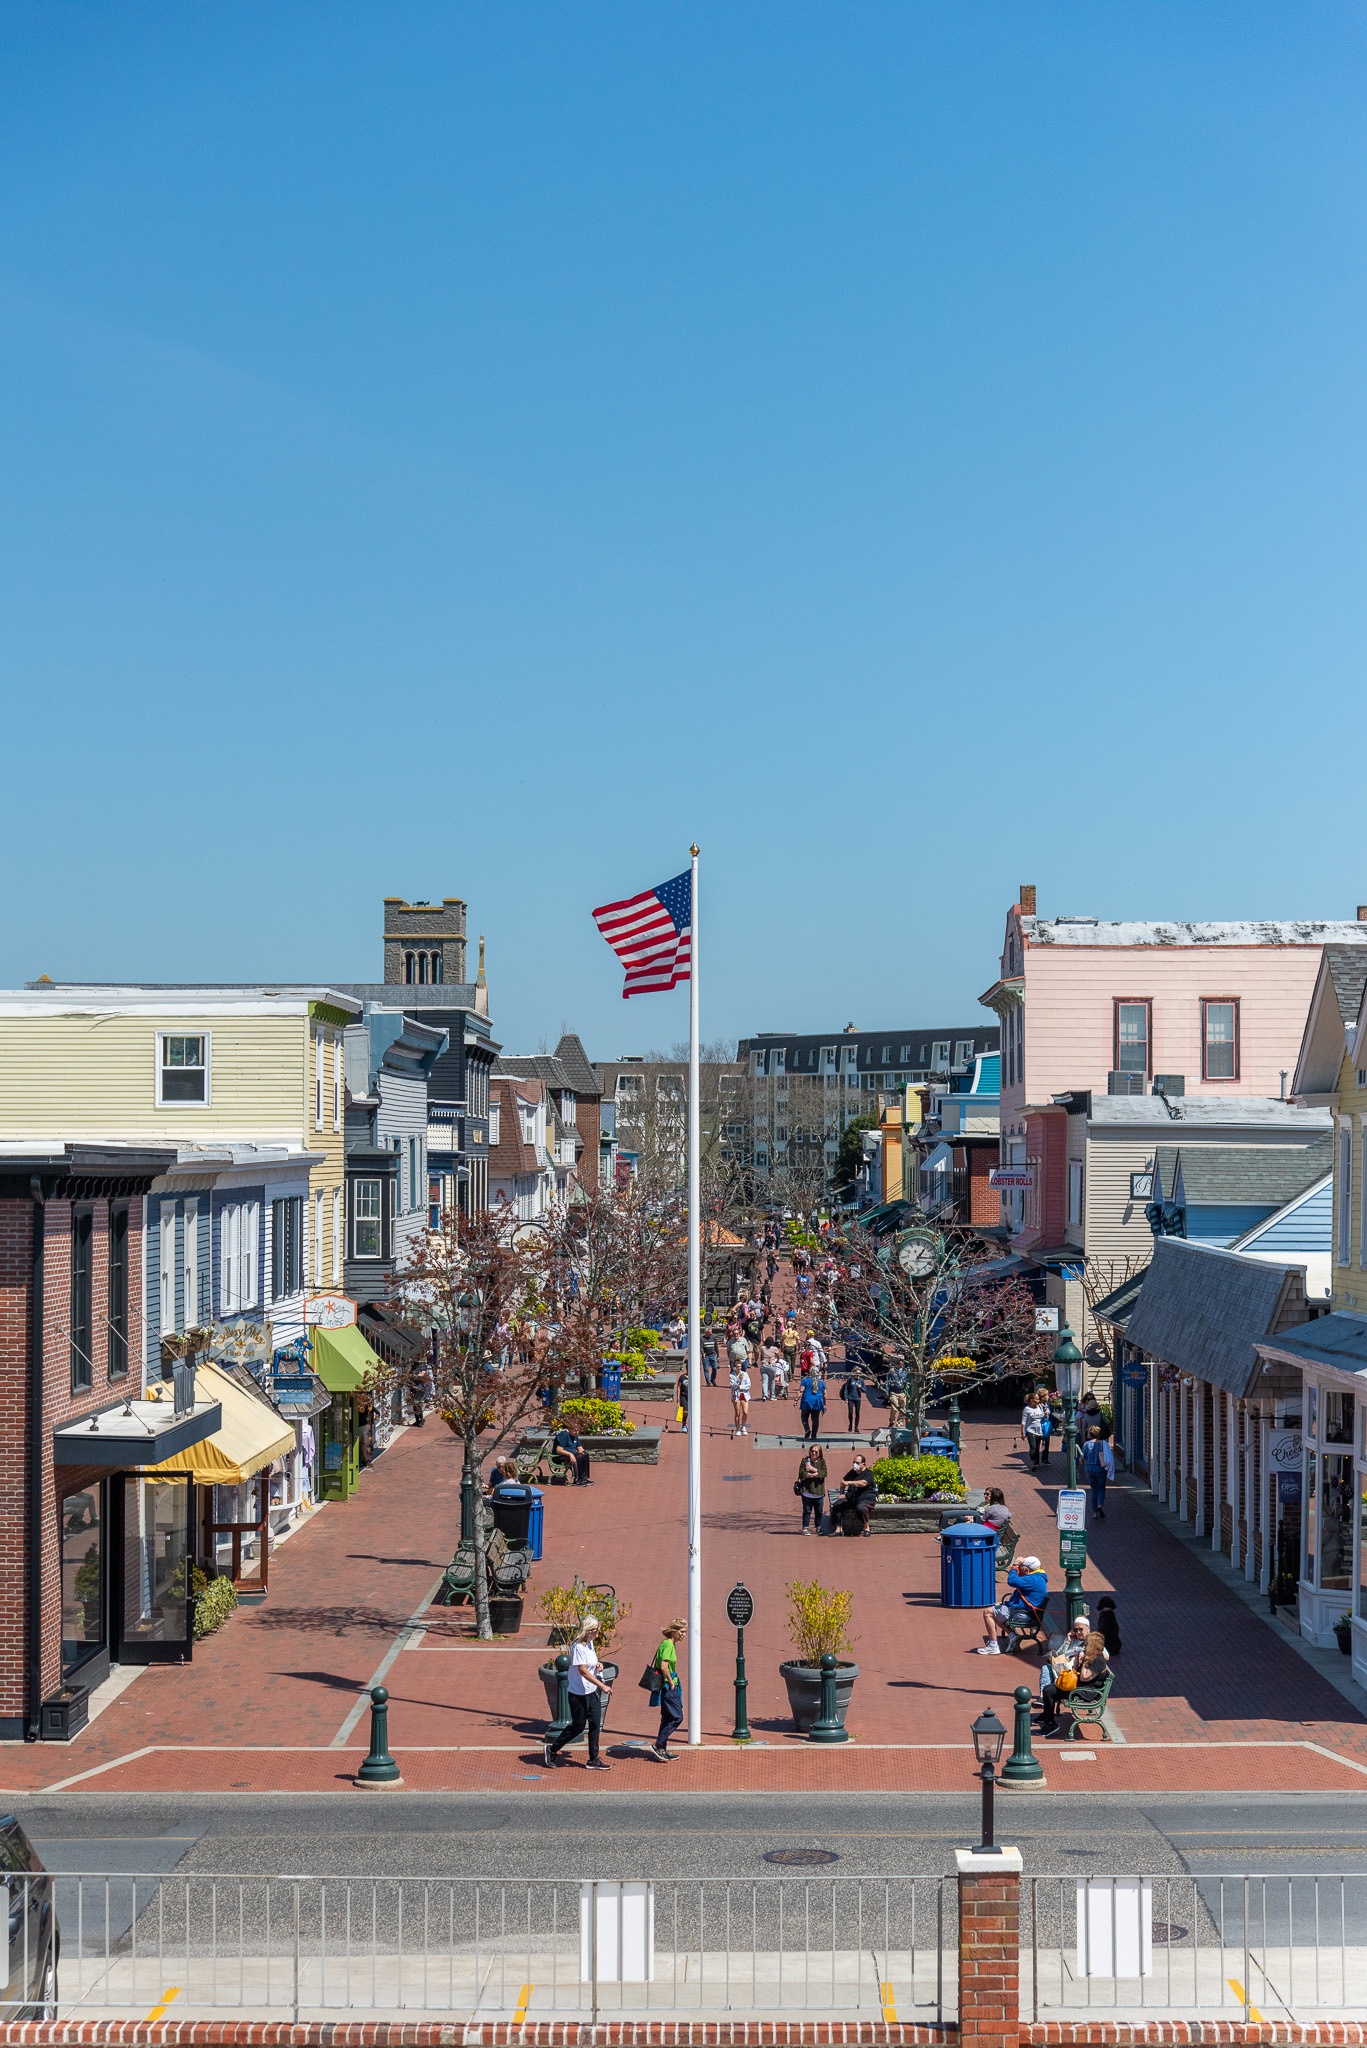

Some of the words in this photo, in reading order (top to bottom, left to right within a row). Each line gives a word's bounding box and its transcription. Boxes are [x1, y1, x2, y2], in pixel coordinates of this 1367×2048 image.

[991, 1177, 1015, 1186] LOBSTER
[1016, 1177, 1033, 1186] ROLLS
[1271, 1444, 1303, 1462] Chees
